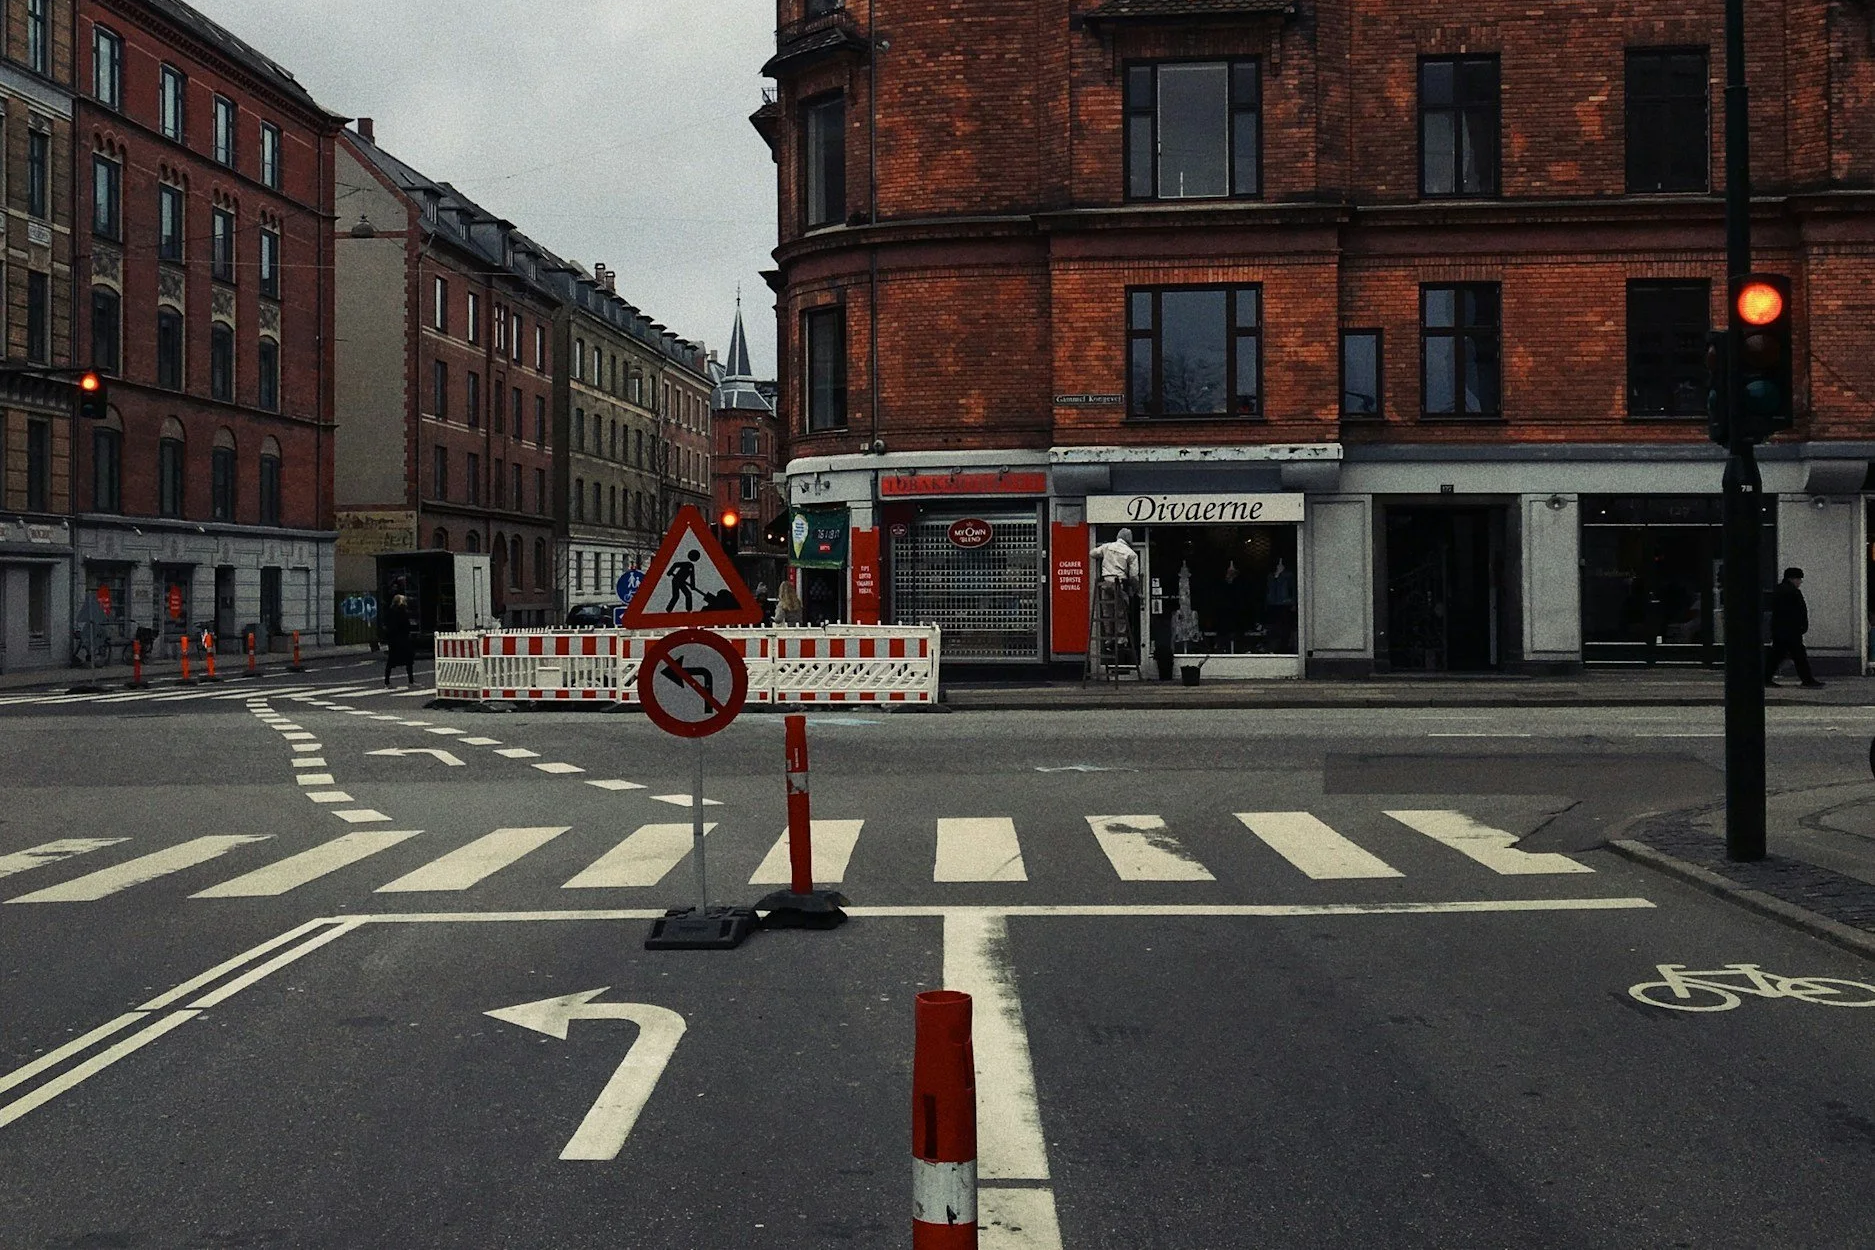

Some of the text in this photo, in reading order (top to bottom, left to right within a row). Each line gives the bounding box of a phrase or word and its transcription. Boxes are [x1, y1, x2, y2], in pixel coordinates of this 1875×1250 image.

[1056, 395, 1086, 403] Gammel
[1127, 496, 1263, 521] Divaerne
[965, 527, 986, 537] OWN
